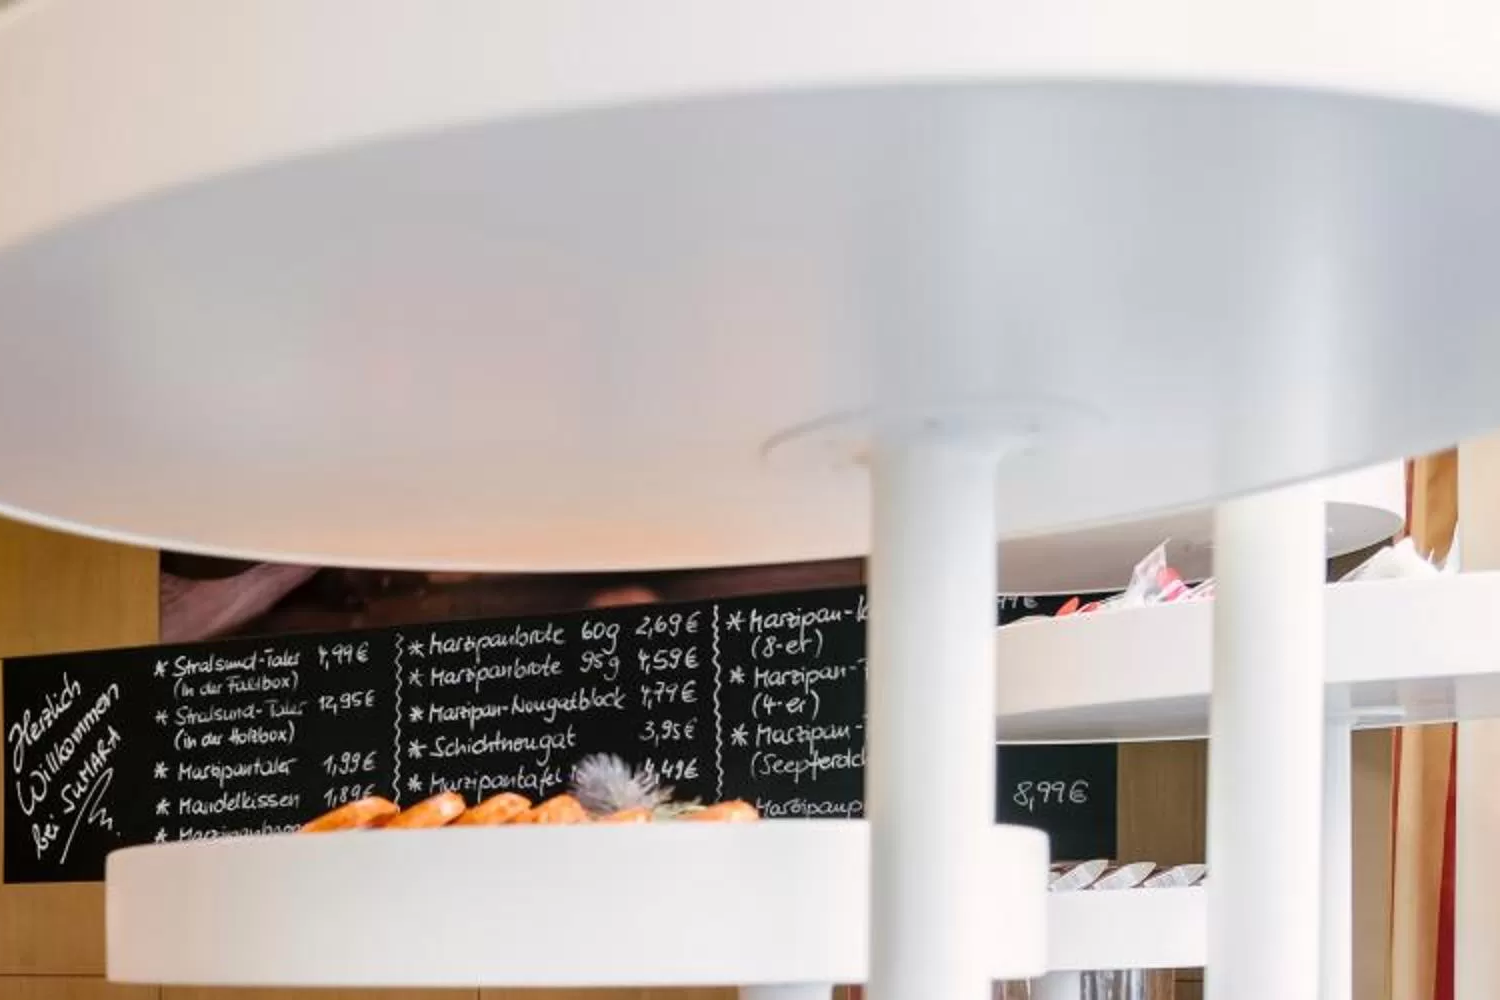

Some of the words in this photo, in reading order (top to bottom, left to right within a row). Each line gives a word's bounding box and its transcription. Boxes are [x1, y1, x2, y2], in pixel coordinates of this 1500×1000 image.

[430, 623, 566, 665] Marzipanbrote
[581, 620, 621, 654] 60g
[635, 611, 701, 639] 2,69€
[431, 654, 563, 693] Marzipanbrote
[580, 651, 621, 680] 95g
[637, 646, 699, 675] 4,59€
[8, 671, 81, 774] Herzlich
[319, 689, 376, 715] 12,95€
[752, 689, 820, 721] (4-er)
[16, 683, 119, 816] Willkommen
[429, 724, 577, 766] Schichtnougat
[639, 717, 698, 746] 3,95€
[323, 751, 378, 777] 1,99€
[430, 765, 563, 804] Marzipantafel
[179, 792, 300, 815] Mandelkissen
[1013, 779, 1089, 812] 8,99€
[32, 814, 60, 860] bei
